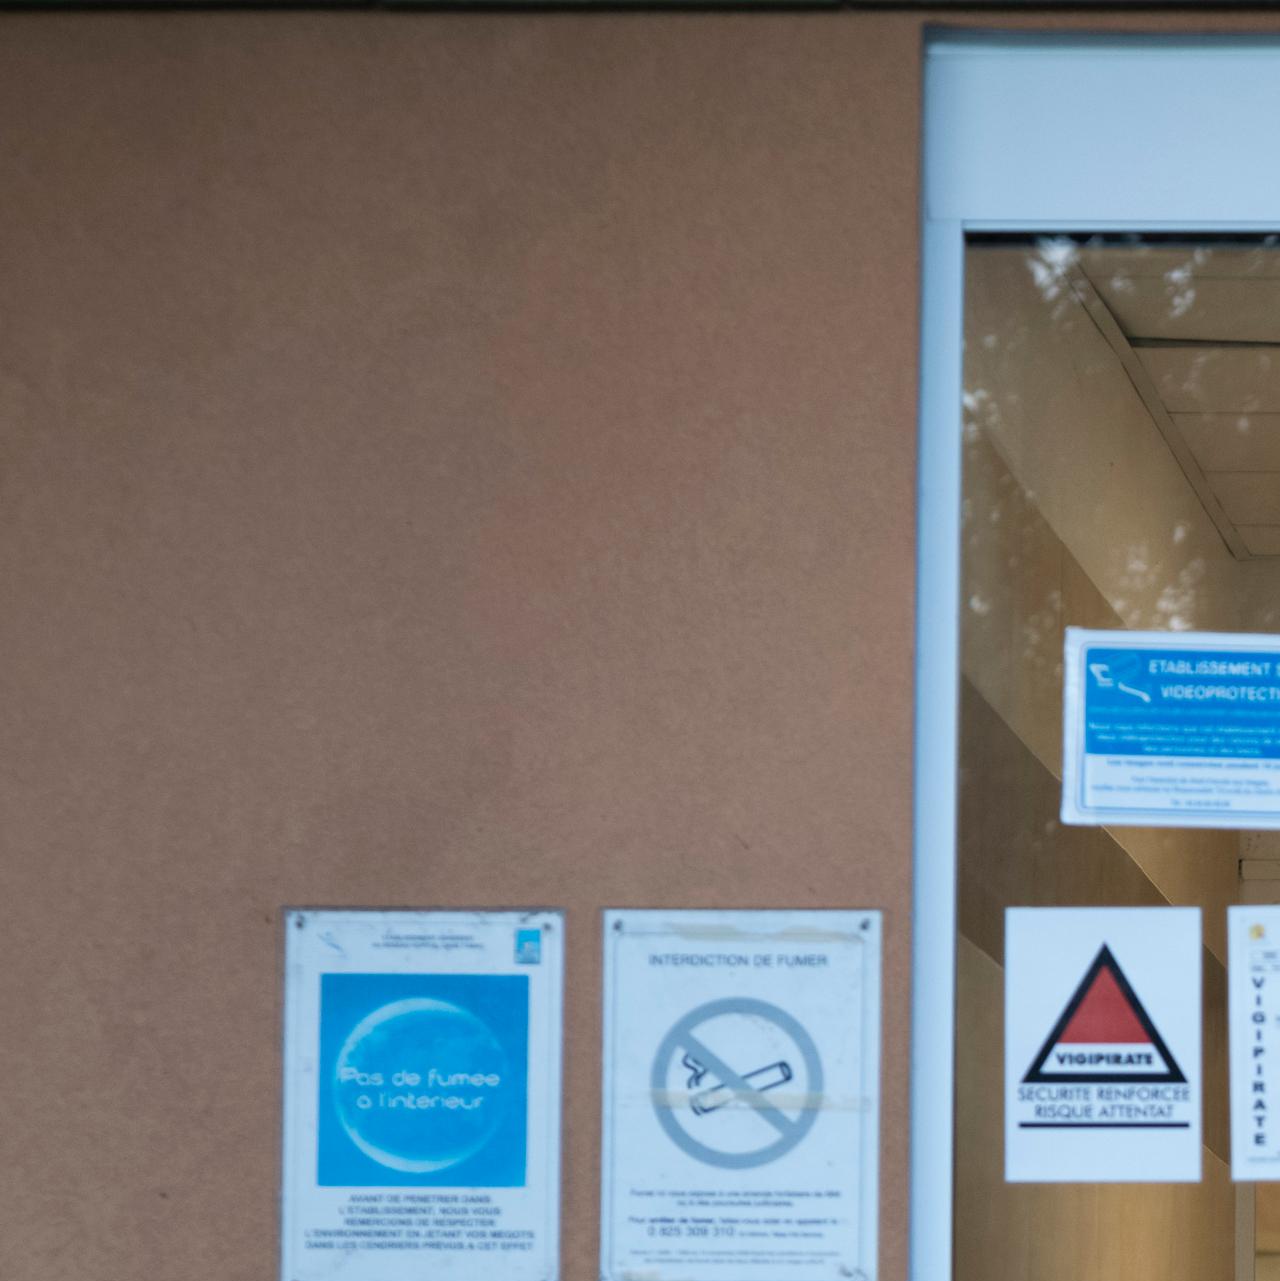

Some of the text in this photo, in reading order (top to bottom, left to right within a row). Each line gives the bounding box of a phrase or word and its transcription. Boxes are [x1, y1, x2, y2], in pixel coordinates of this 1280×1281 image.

[649, 954, 827, 967] INTERDICTION DE FUMER
[1056, 1053, 1152, 1066] VIGIPIRATE
[1252, 978, 1265, 1145] VIGIPIRATE
[340, 1067, 383, 1087] Pas
[392, 1067, 420, 1087] de
[1035, 1104, 1173, 1118] RISQUE ATTENTAT
